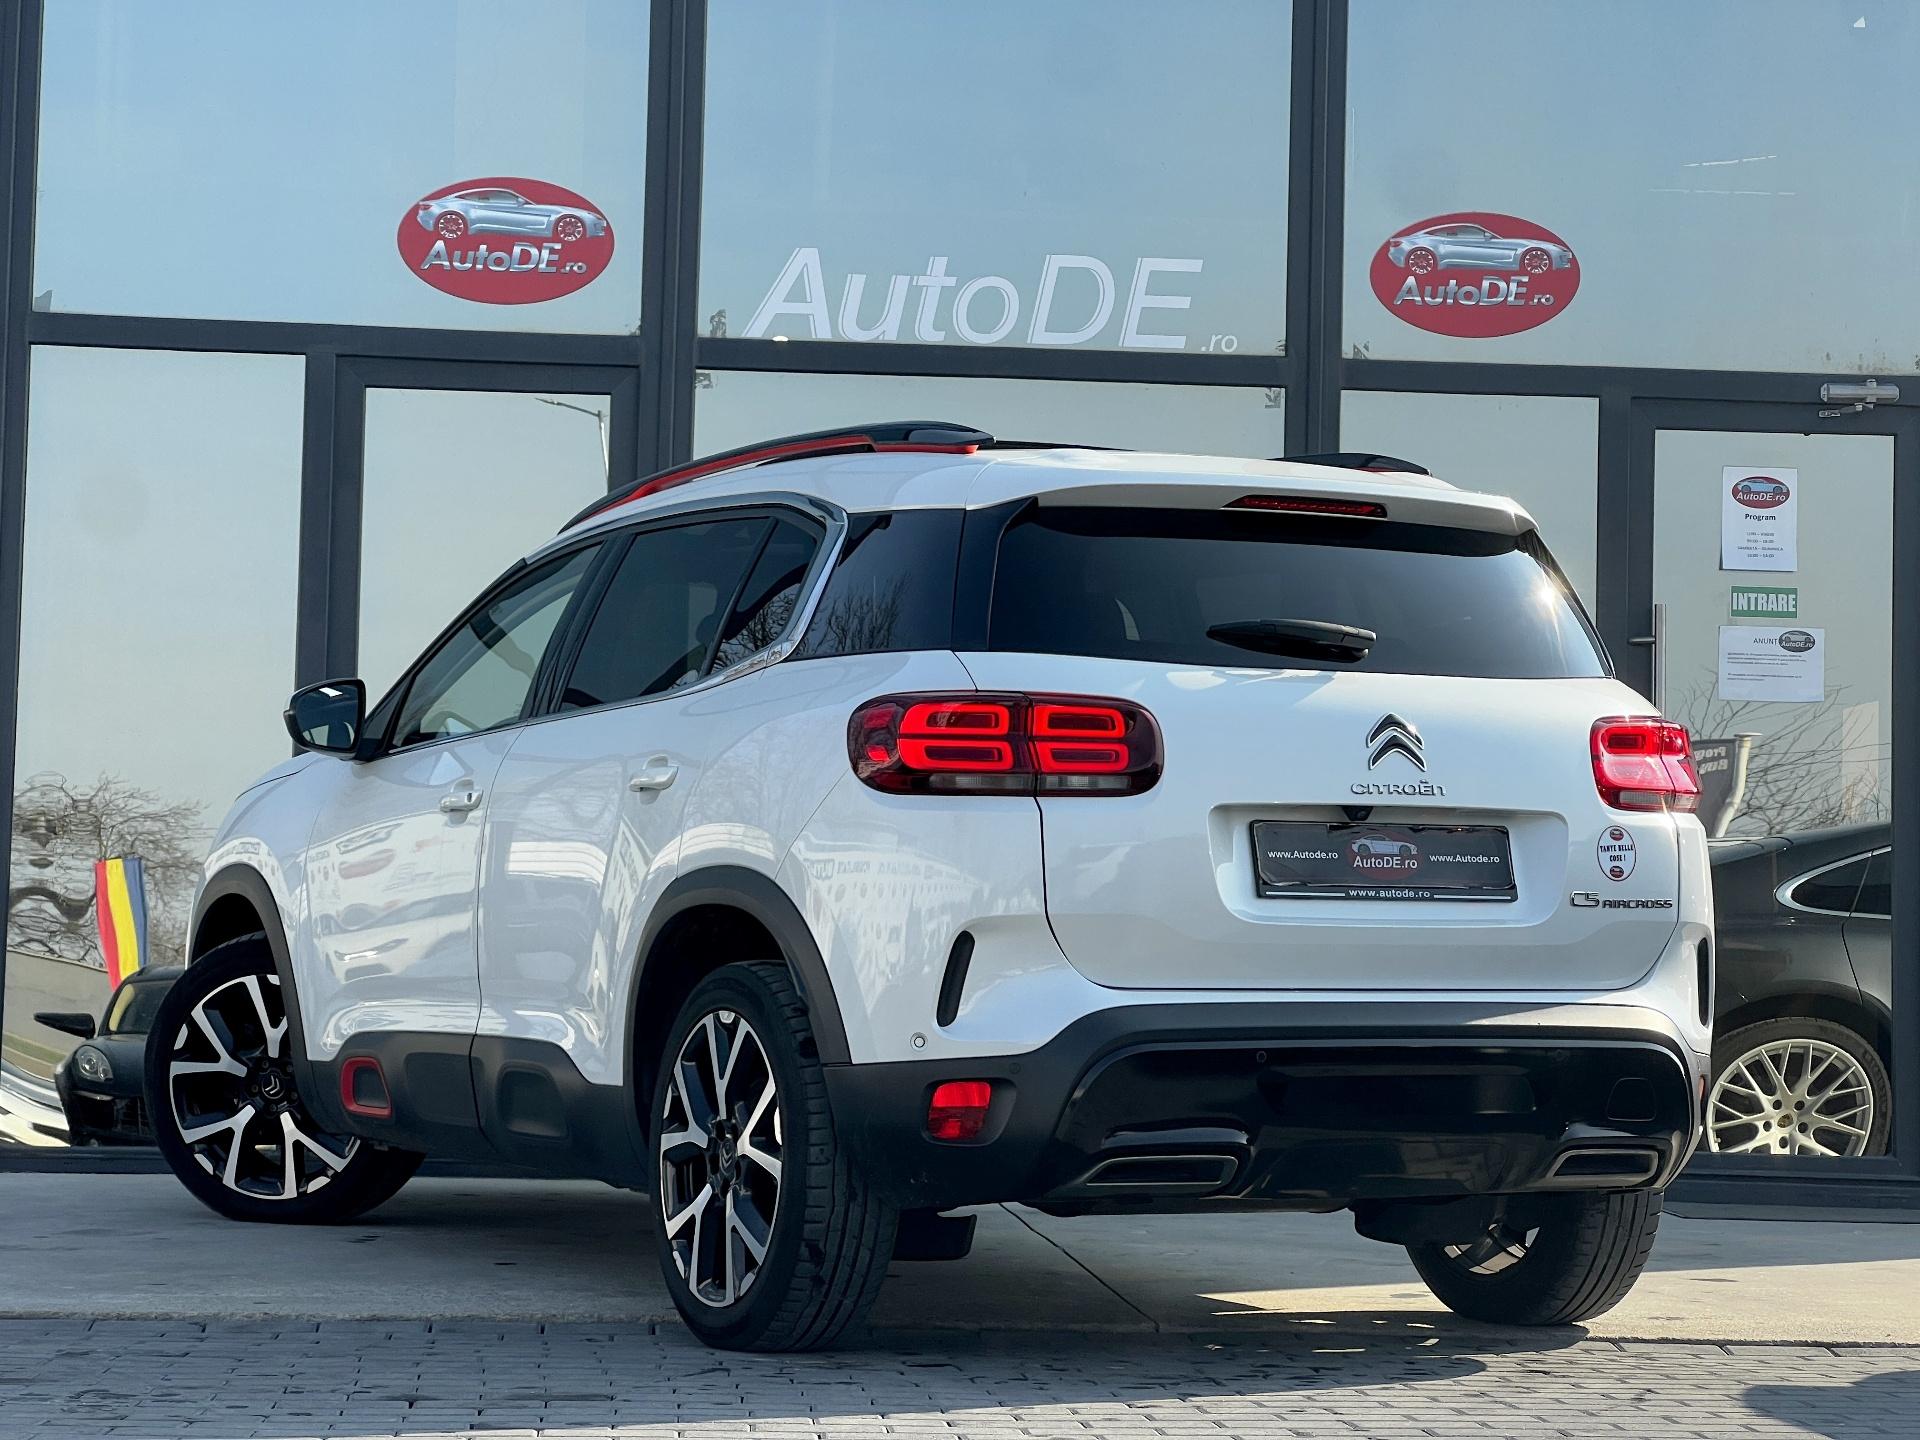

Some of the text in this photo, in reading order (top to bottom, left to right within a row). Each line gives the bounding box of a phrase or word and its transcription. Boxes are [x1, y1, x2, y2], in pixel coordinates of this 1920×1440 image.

[1736, 492, 1786, 502] AutoDE.ro
[1744, 513, 1776, 521] Program
[1732, 592, 1797, 612] INTRARE
[1618, 844, 1634, 852] BELLE
[1267, 849, 1500, 870] www.Autode.ro AutoDE.ro www.Autode.ro
[1349, 888, 1431, 899] www.autode.ro
[1602, 899, 1673, 909] AIRCROSS
